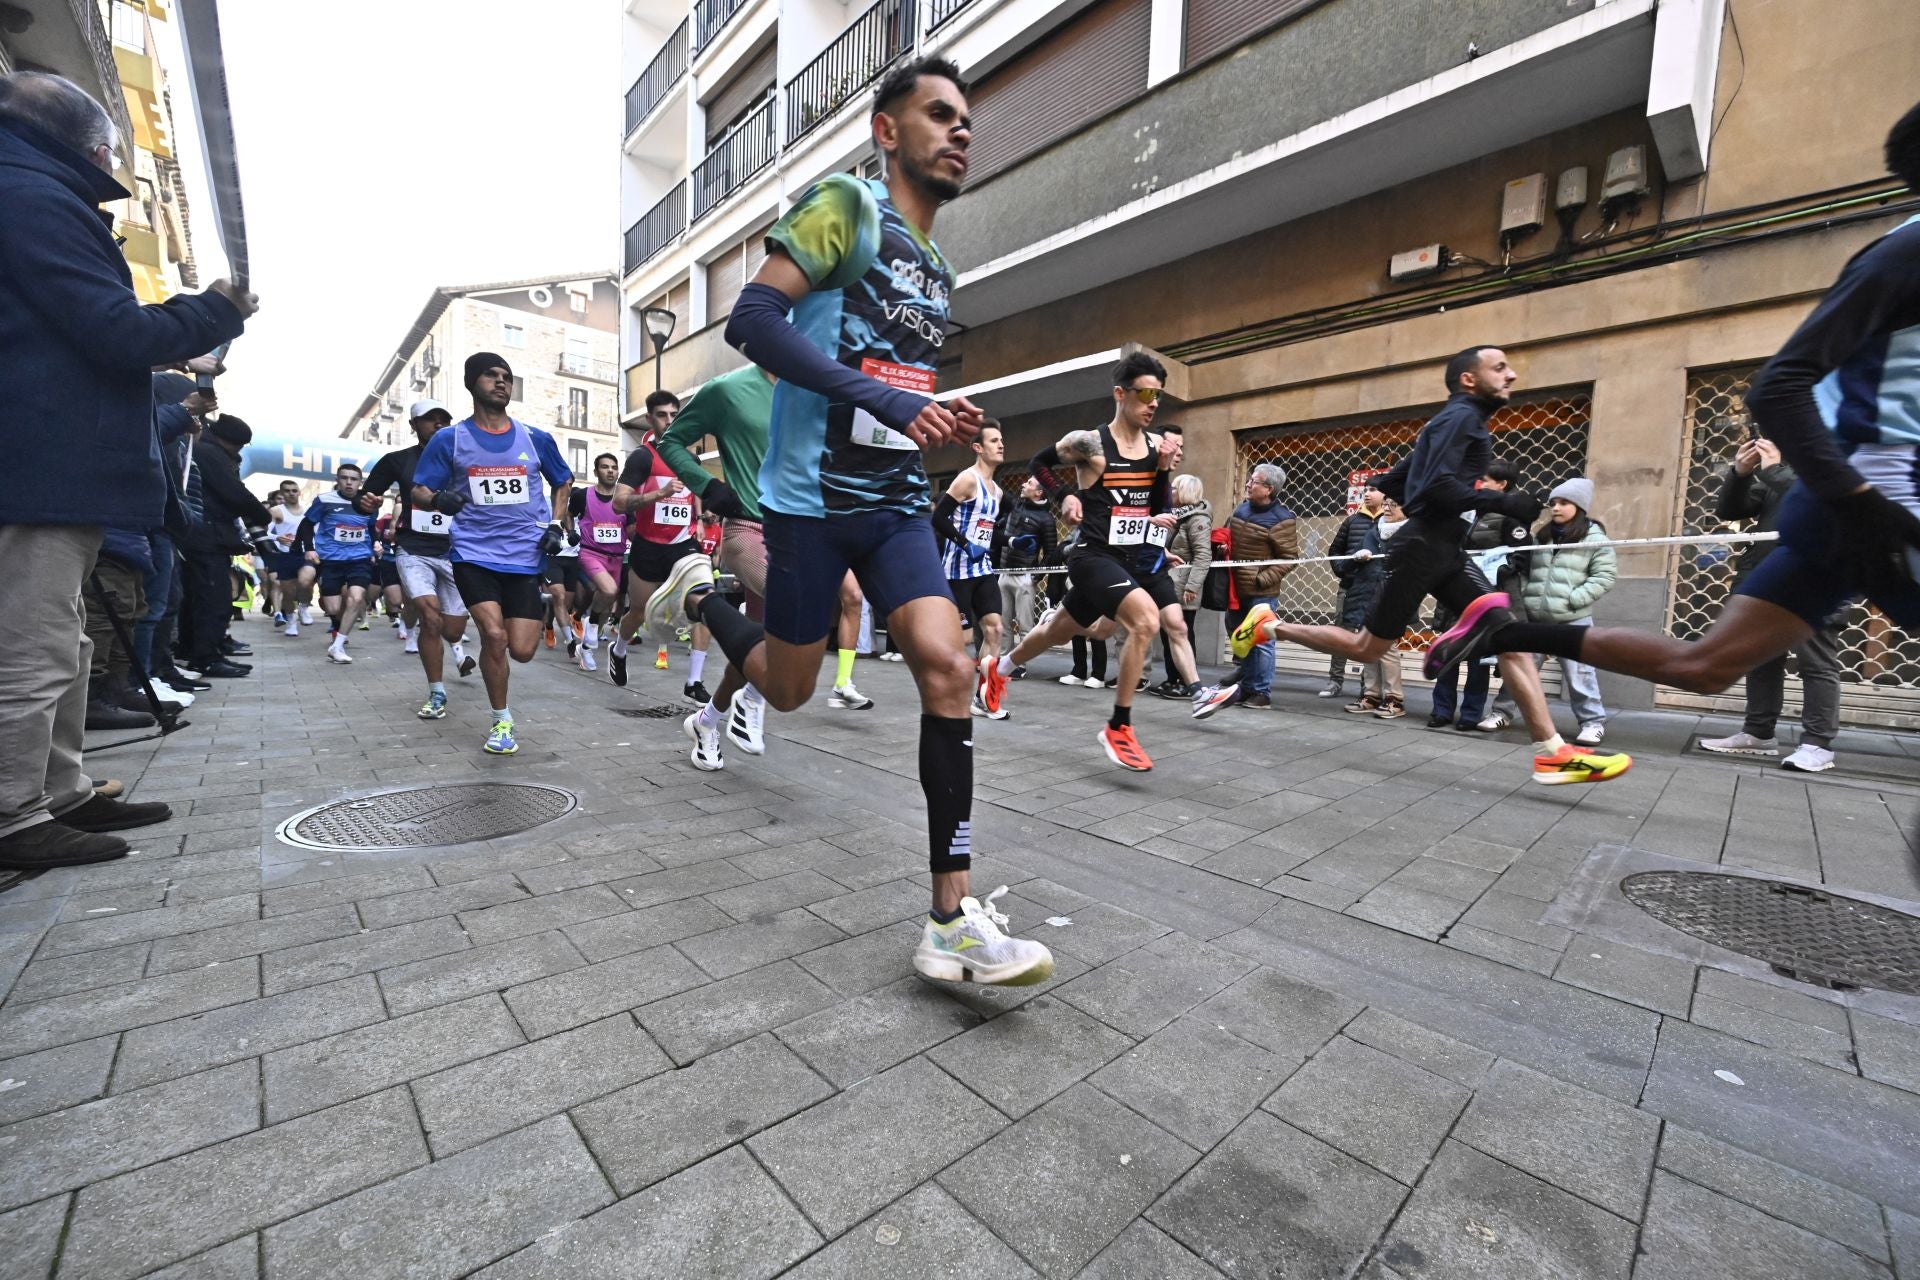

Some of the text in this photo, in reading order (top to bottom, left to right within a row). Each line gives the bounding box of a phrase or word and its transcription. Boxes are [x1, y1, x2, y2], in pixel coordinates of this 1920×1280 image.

[479, 478, 522, 495] 138
[661, 505, 688, 518] 166
[431, 514, 442, 526] 8
[1117, 519, 1144, 535] 389
[340, 530, 362, 538] 218
[597, 529, 618, 538] 353
